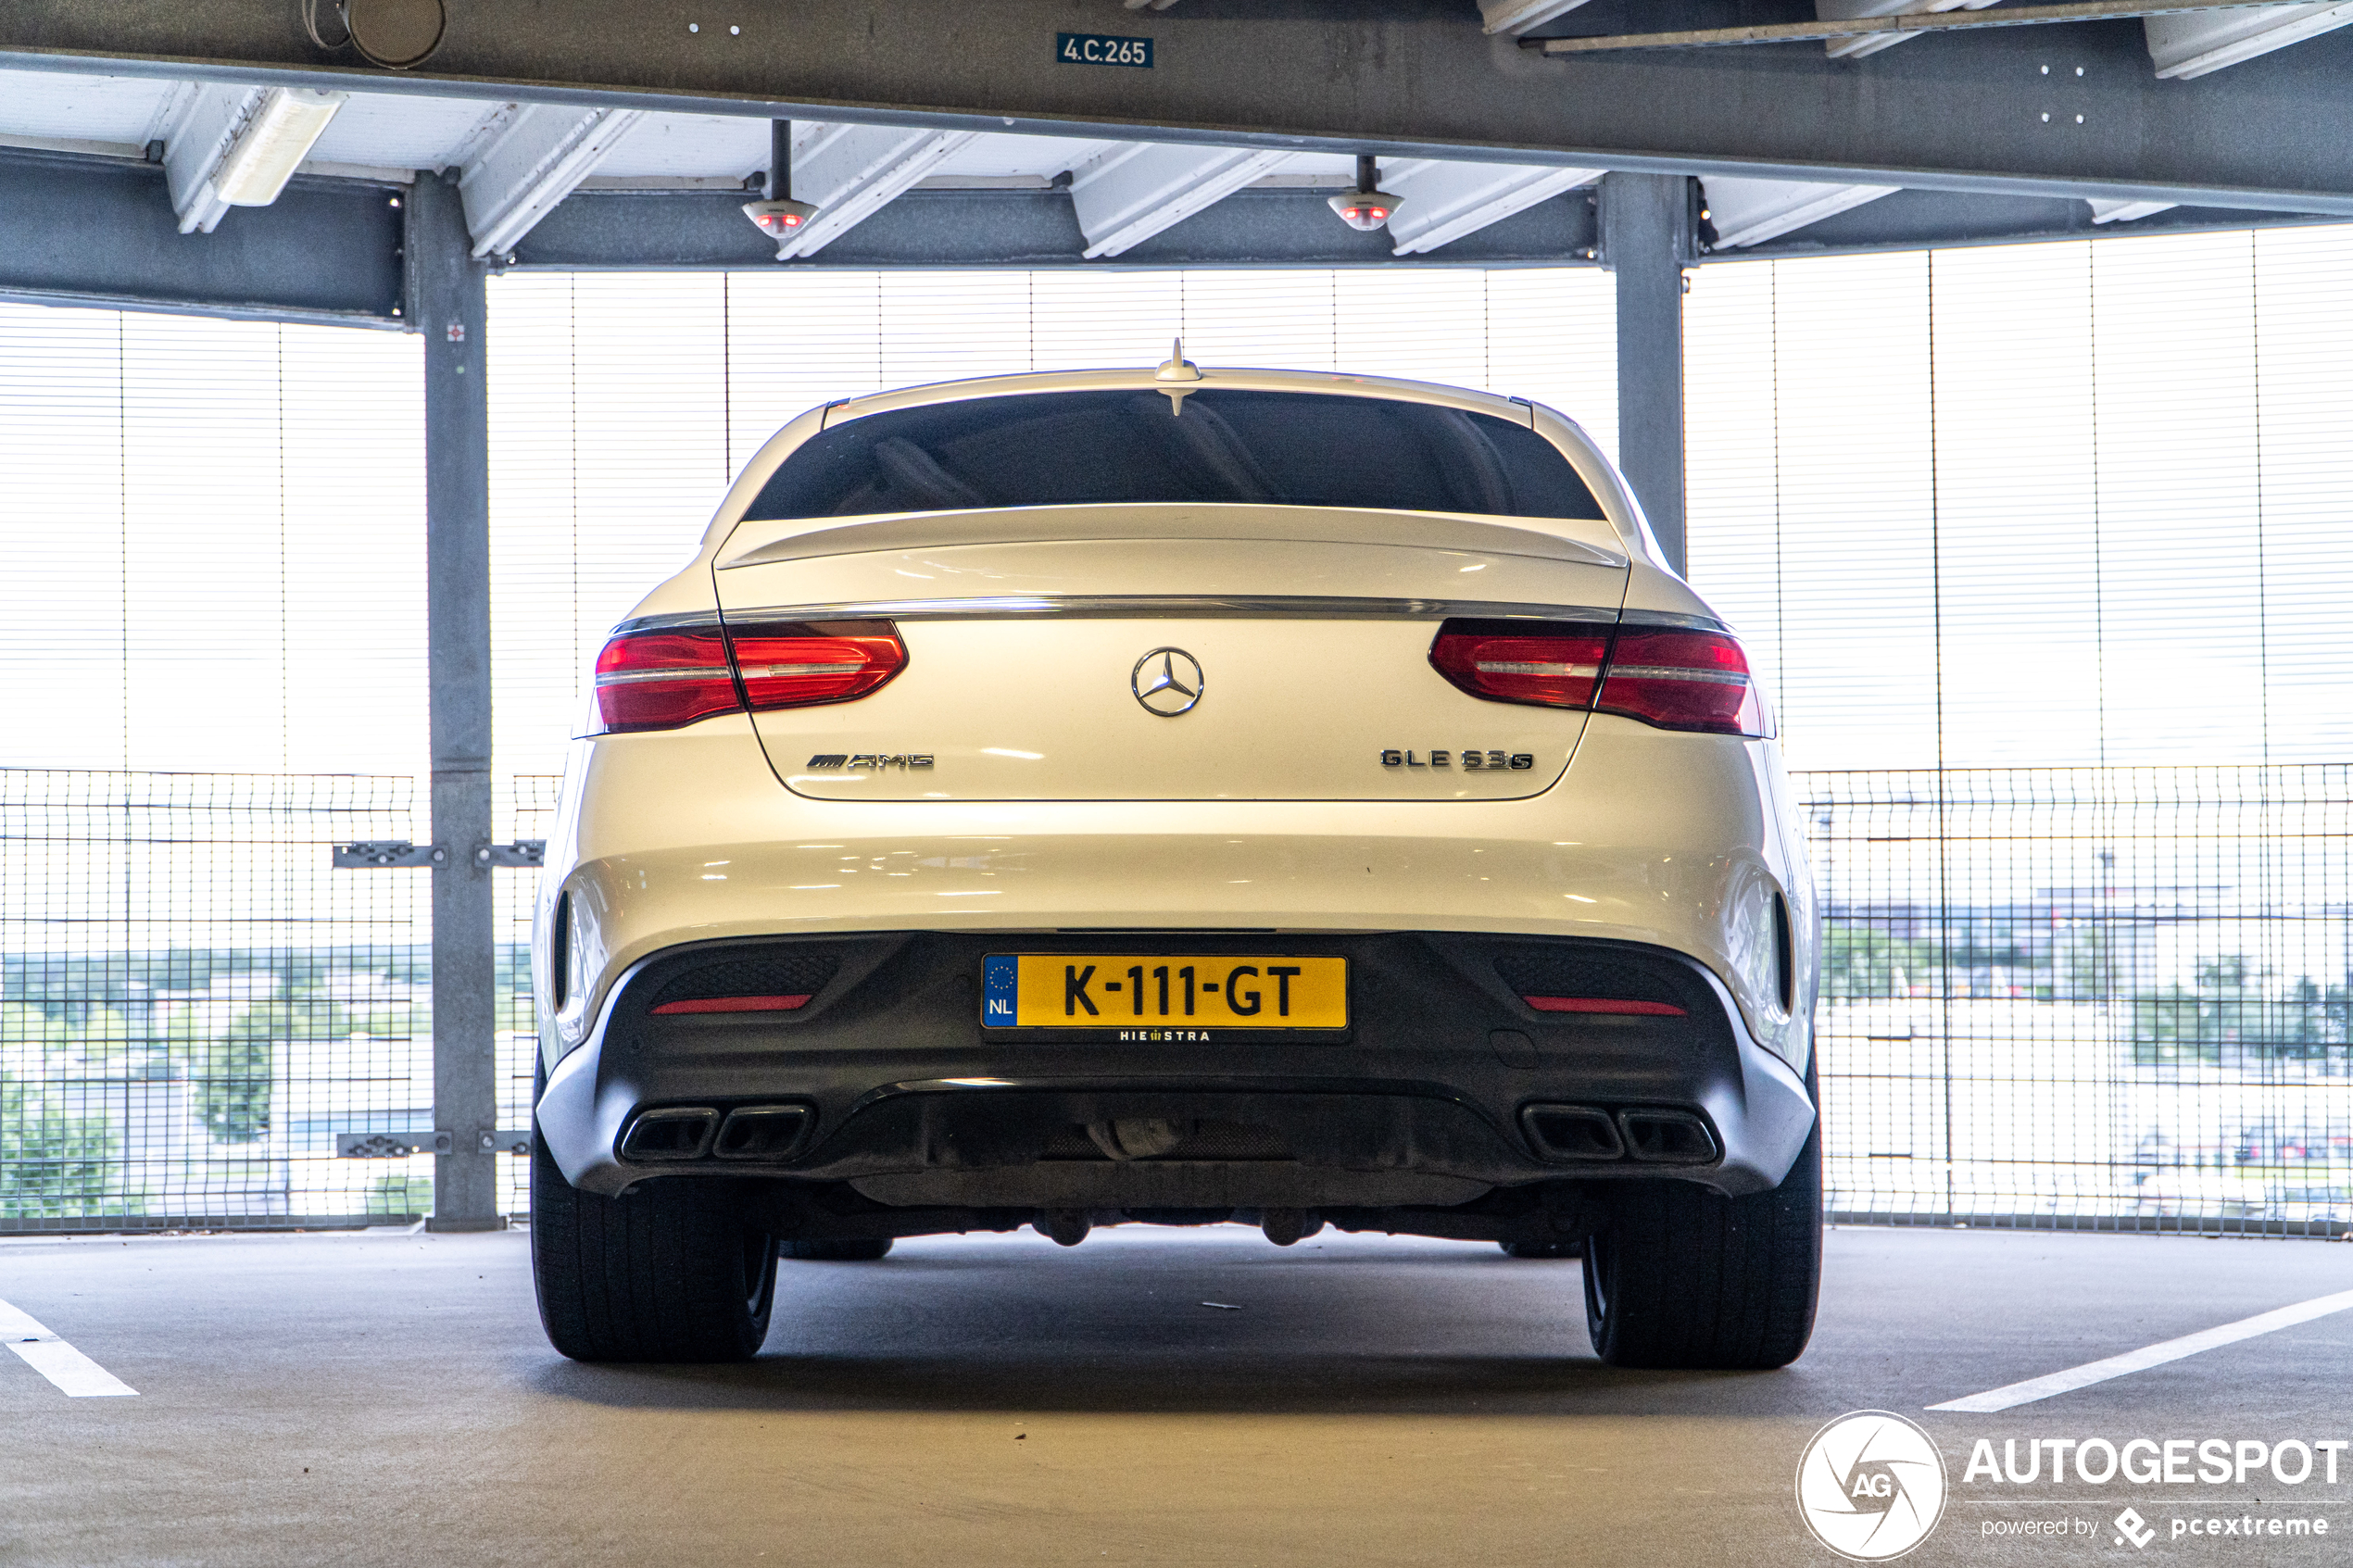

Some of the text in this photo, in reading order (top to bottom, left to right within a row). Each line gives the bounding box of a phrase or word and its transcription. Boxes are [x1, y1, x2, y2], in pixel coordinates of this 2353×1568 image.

[1063, 38, 1146, 64] 4.C.265
[1380, 749, 1451, 767] GLE
[1064, 965, 1301, 1016] K-111-GT
[989, 999, 1013, 1015] NL
